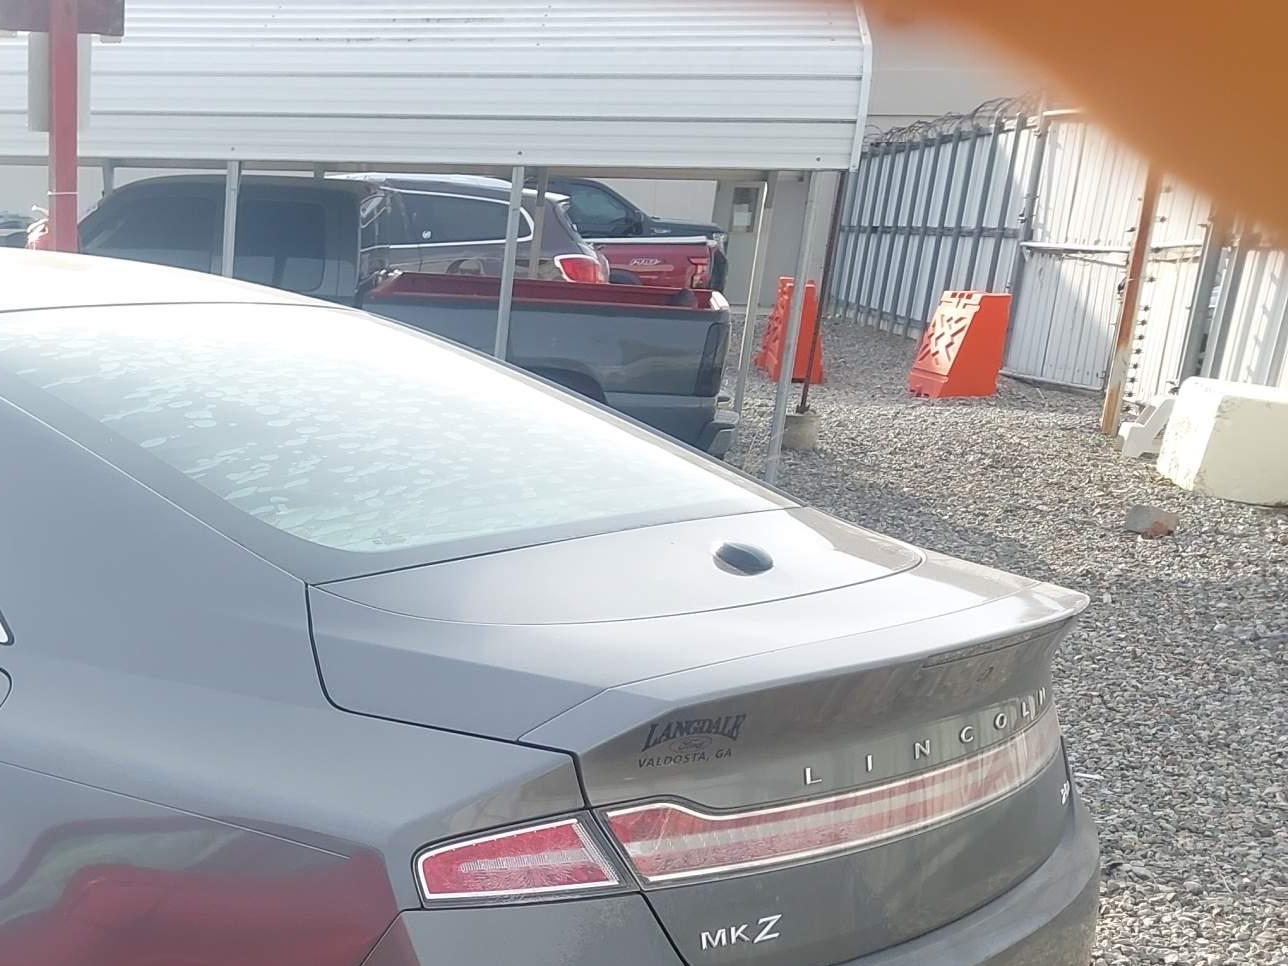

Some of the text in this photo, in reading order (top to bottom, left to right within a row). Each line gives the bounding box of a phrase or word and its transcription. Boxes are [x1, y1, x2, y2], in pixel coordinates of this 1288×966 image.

[640, 713, 747, 753] LANGDALE
[804, 687, 1047, 785] LINCOLN
[638, 748, 732, 768] VALDOSTA, GA
[700, 913, 782, 951] MKZ
